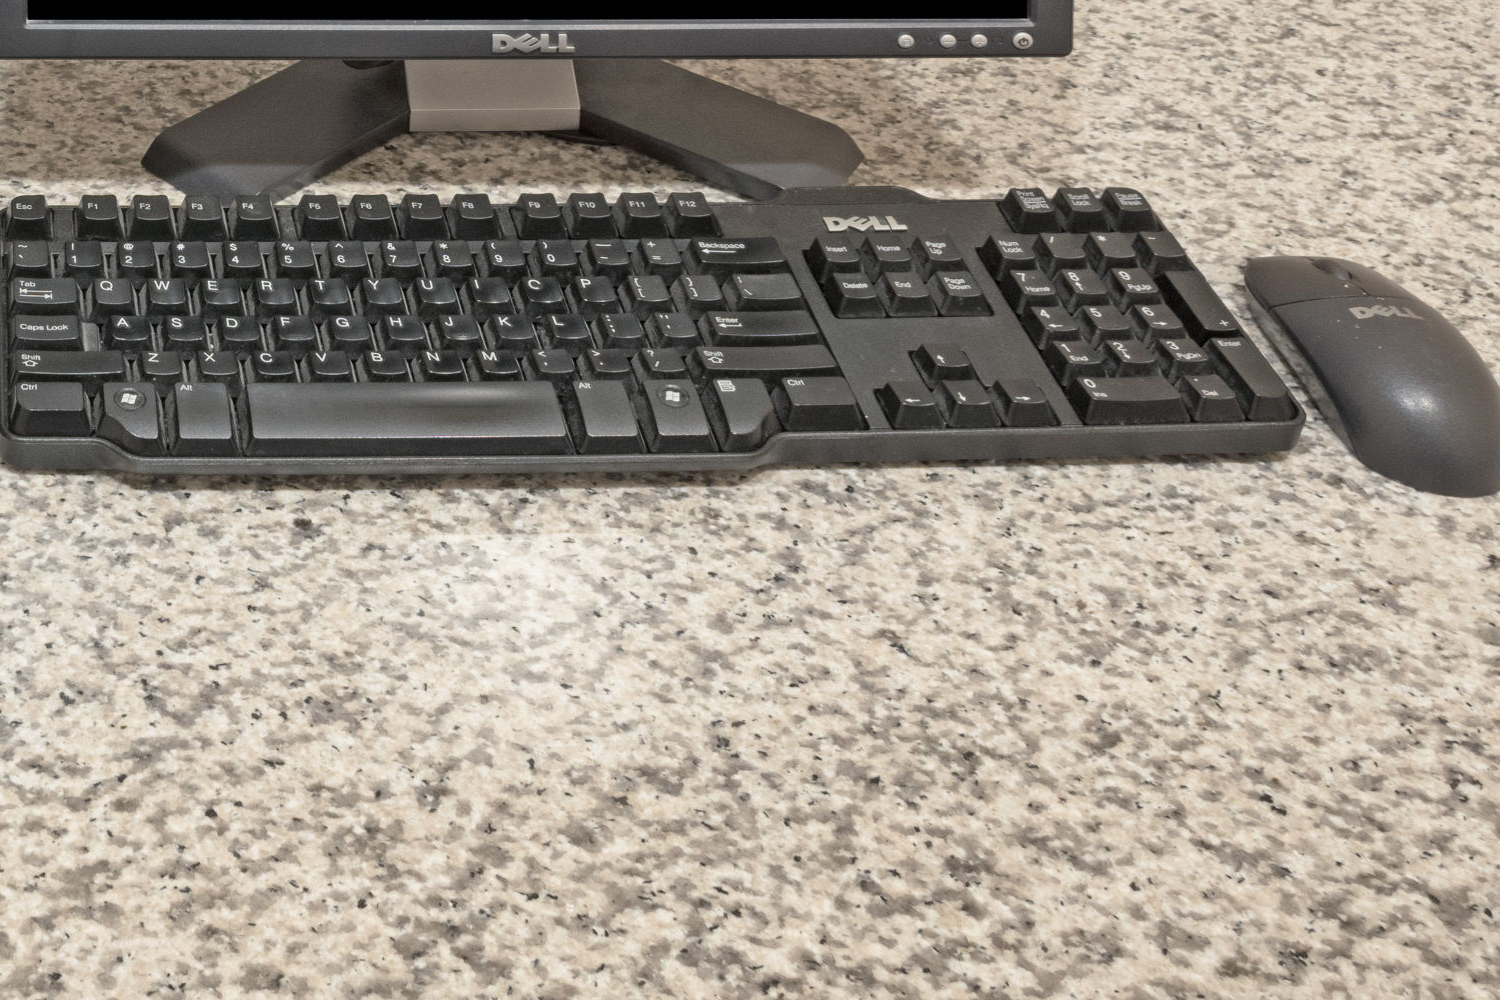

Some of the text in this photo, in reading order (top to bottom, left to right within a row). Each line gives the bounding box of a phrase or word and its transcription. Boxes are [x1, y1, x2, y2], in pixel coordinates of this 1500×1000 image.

[491, 32, 576, 54] DELL
[15, 202, 33, 210] Esc
[87, 202, 99, 210] F1
[139, 202, 151, 210] F2
[191, 202, 204, 211] F3
[241, 202, 254, 210] F4
[308, 202, 322, 210] F5
[360, 202, 373, 210] F6
[411, 201, 423, 209] F7
[461, 201, 475, 209] F8
[528, 201, 541, 209] F9
[578, 201, 596, 209] F10
[628, 200, 646, 208] F11
[678, 200, 697, 208] F12
[822, 215, 909, 232] DELL
[698, 241, 746, 249] Backspace
[71, 255, 77, 264] 1
[124, 255, 133, 264] 2
[177, 255, 186, 264] 3
[231, 255, 240, 264] 4
[284, 255, 293, 264] 5
[336, 254, 346, 264] 6
[389, 254, 397, 264] 7
[442, 254, 452, 264] 8
[494, 254, 503, 263] 9
[546, 253, 556, 263] 0
[1015, 272, 1026, 282] 7
[1067, 271, 1080, 282] 8
[1118, 270, 1132, 281] 9
[19, 280, 36, 288] Tab
[99, 280, 114, 292] Q
[153, 280, 170, 291] W
[207, 280, 219, 291] E
[260, 280, 274, 292] R
[314, 279, 325, 291] T
[367, 279, 380, 290] Y
[420, 279, 434, 291] U
[473, 279, 480, 289] I
[579, 278, 592, 289] P
[1039, 309, 1051, 319] 4
[1089, 307, 1103, 318] 5
[1141, 306, 1155, 317] 6
[1348, 304, 1425, 319] DELL
[116, 317, 130, 328] A
[171, 317, 183, 328] S
[225, 317, 239, 329] D
[280, 316, 291, 327] F
[335, 316, 350, 328] G
[389, 316, 403, 327] H
[444, 316, 454, 327] J
[497, 316, 512, 327] K
[551, 315, 565, 327] L
[715, 315, 739, 324] Enter
[19, 323, 69, 332] Caps Lock
[1060, 343, 1072, 353] 1
[1112, 341, 1126, 350] 2
[1165, 340, 1180, 351] 3
[20, 353, 41, 361] Shift
[147, 352, 160, 363] Z
[203, 351, 216, 363] X
[259, 352, 273, 363] C
[315, 352, 327, 362] V
[370, 351, 384, 362] B
[425, 351, 440, 362] N
[481, 350, 498, 361] M
[703, 350, 724, 358] Shift
[1068, 354, 1089, 362] End
[1175, 352, 1202, 361] PgDn
[20, 383, 38, 391] Ctrl
[179, 383, 193, 392] Alt
[786, 379, 805, 387] Ctrl
[1083, 378, 1097, 389] 0
